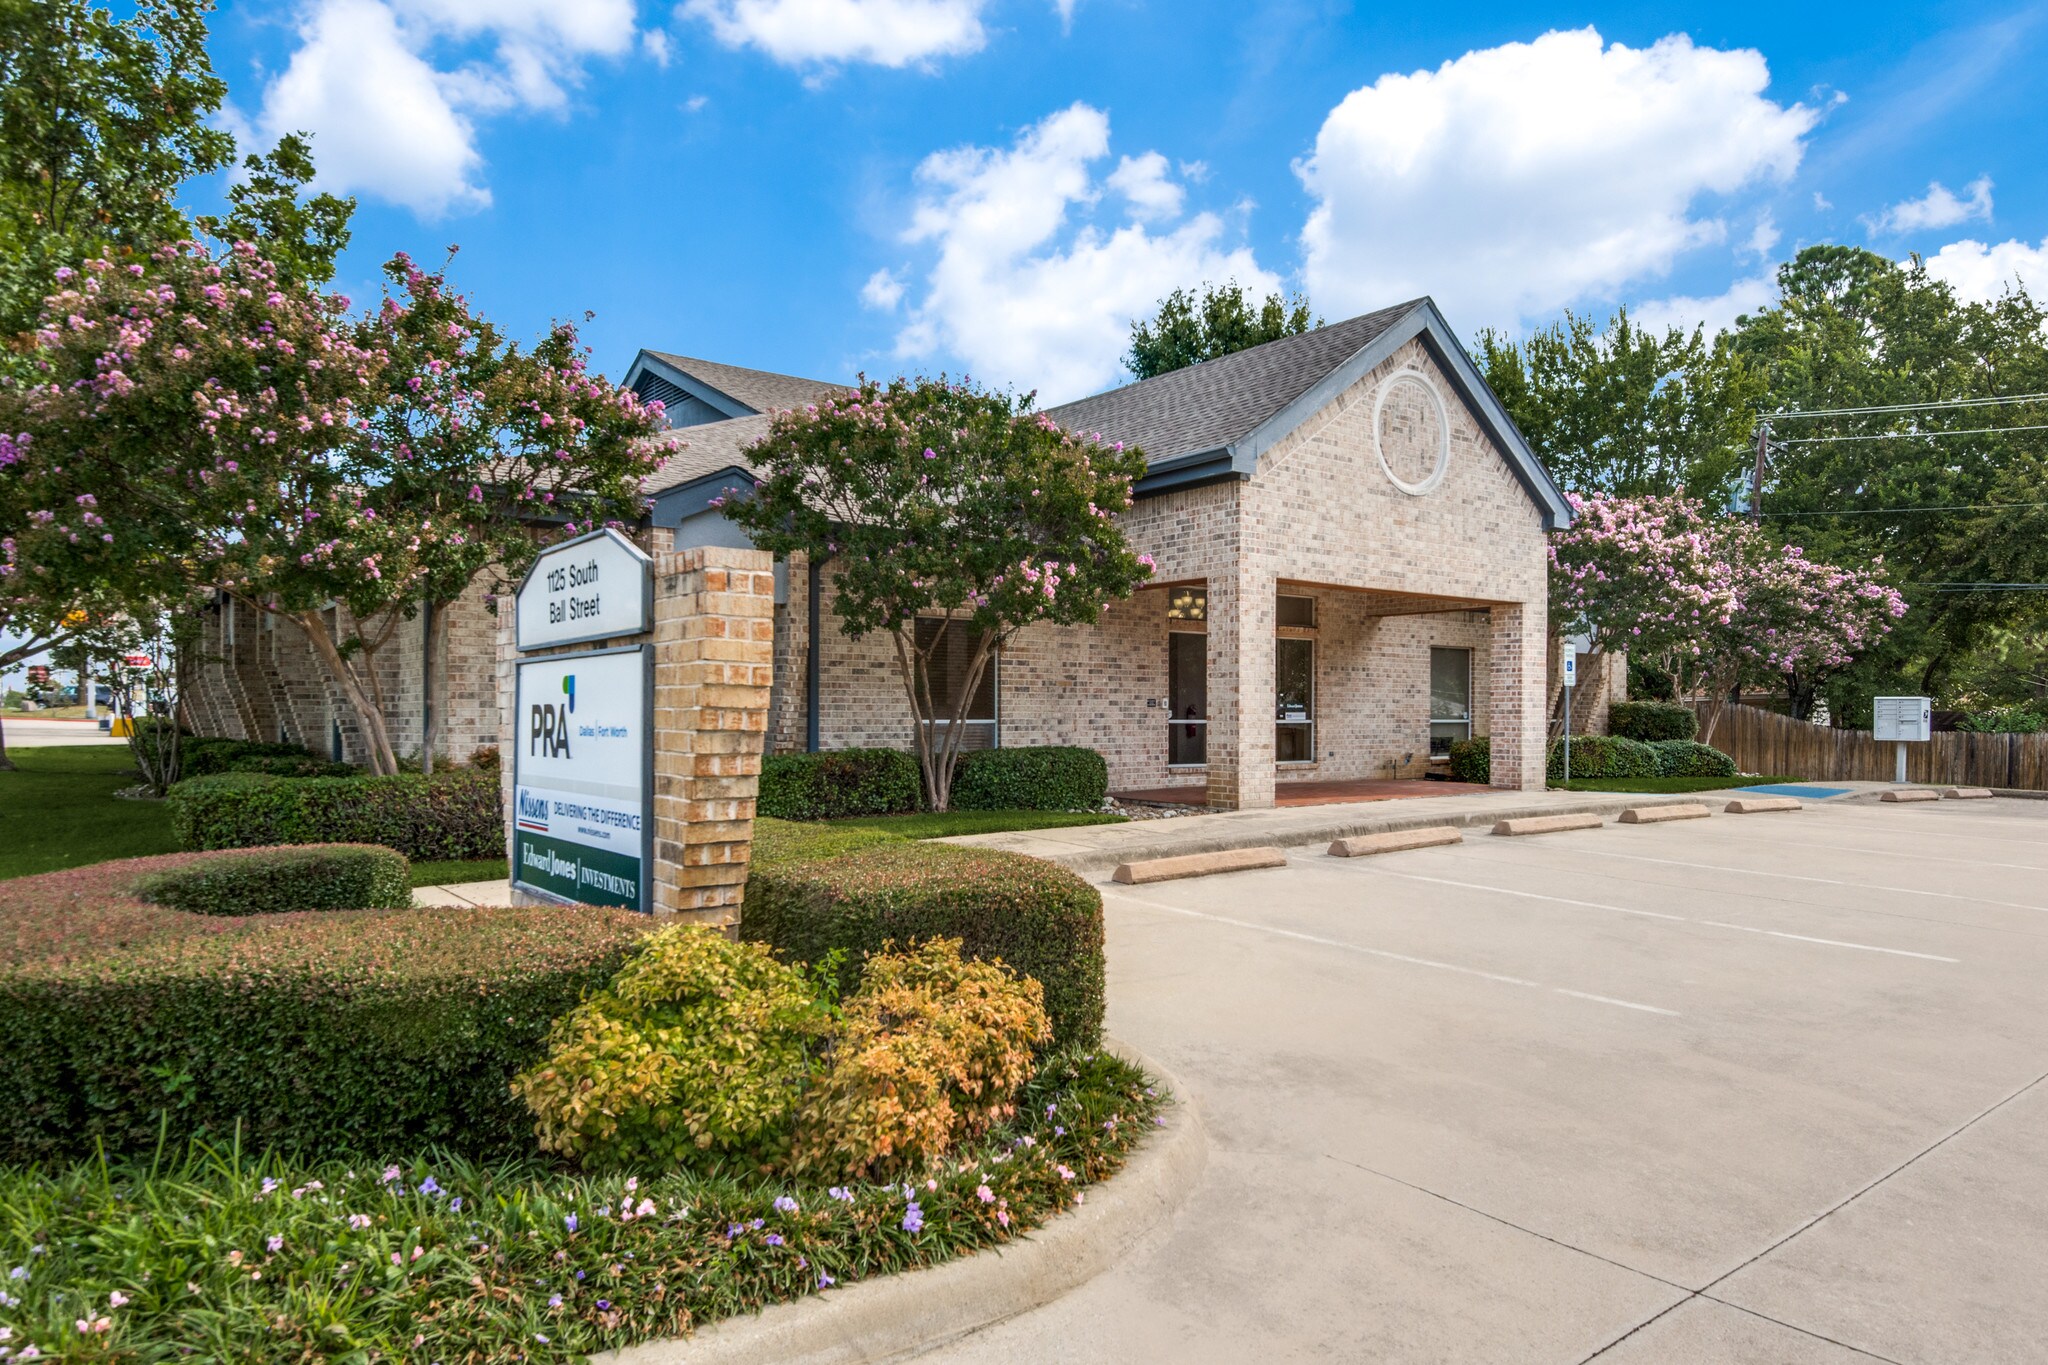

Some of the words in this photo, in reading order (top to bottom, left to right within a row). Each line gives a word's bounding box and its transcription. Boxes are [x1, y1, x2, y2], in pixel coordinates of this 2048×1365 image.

[547, 568, 566, 593] 1125
[569, 559, 599, 588] South
[549, 600, 566, 624] Ball
[569, 593, 600, 620] Street
[531, 703, 570, 759] PRA
[519, 788, 548, 820] Nissens
[554, 801, 587, 820] DELIVERING
[587, 807, 600, 823] THE
[601, 809, 640, 831] DIFFERENCE
[581, 866, 636, 899] INVESTMENTS
